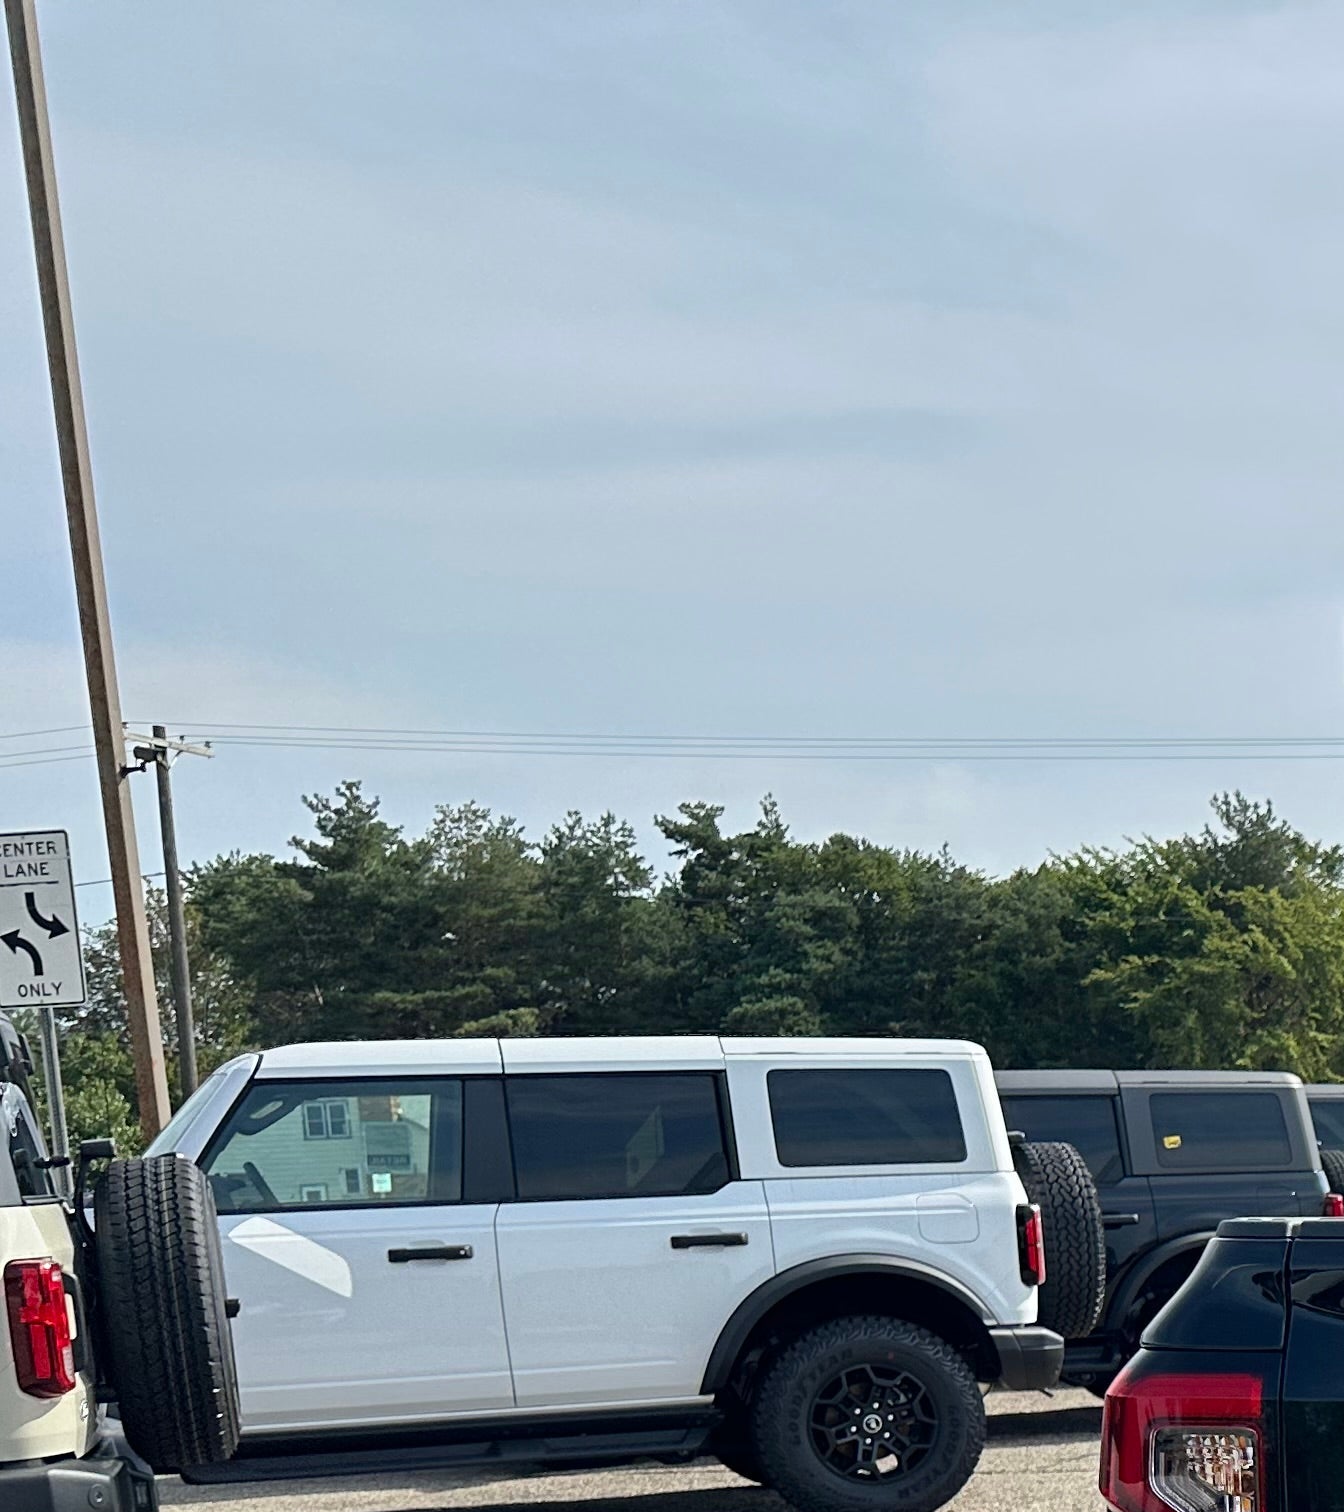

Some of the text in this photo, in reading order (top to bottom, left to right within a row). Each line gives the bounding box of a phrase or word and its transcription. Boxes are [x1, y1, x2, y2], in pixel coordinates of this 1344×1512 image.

[0, 841, 57, 857] ENTER
[4, 862, 50, 878] LANE
[18, 981, 62, 997] ONLY
